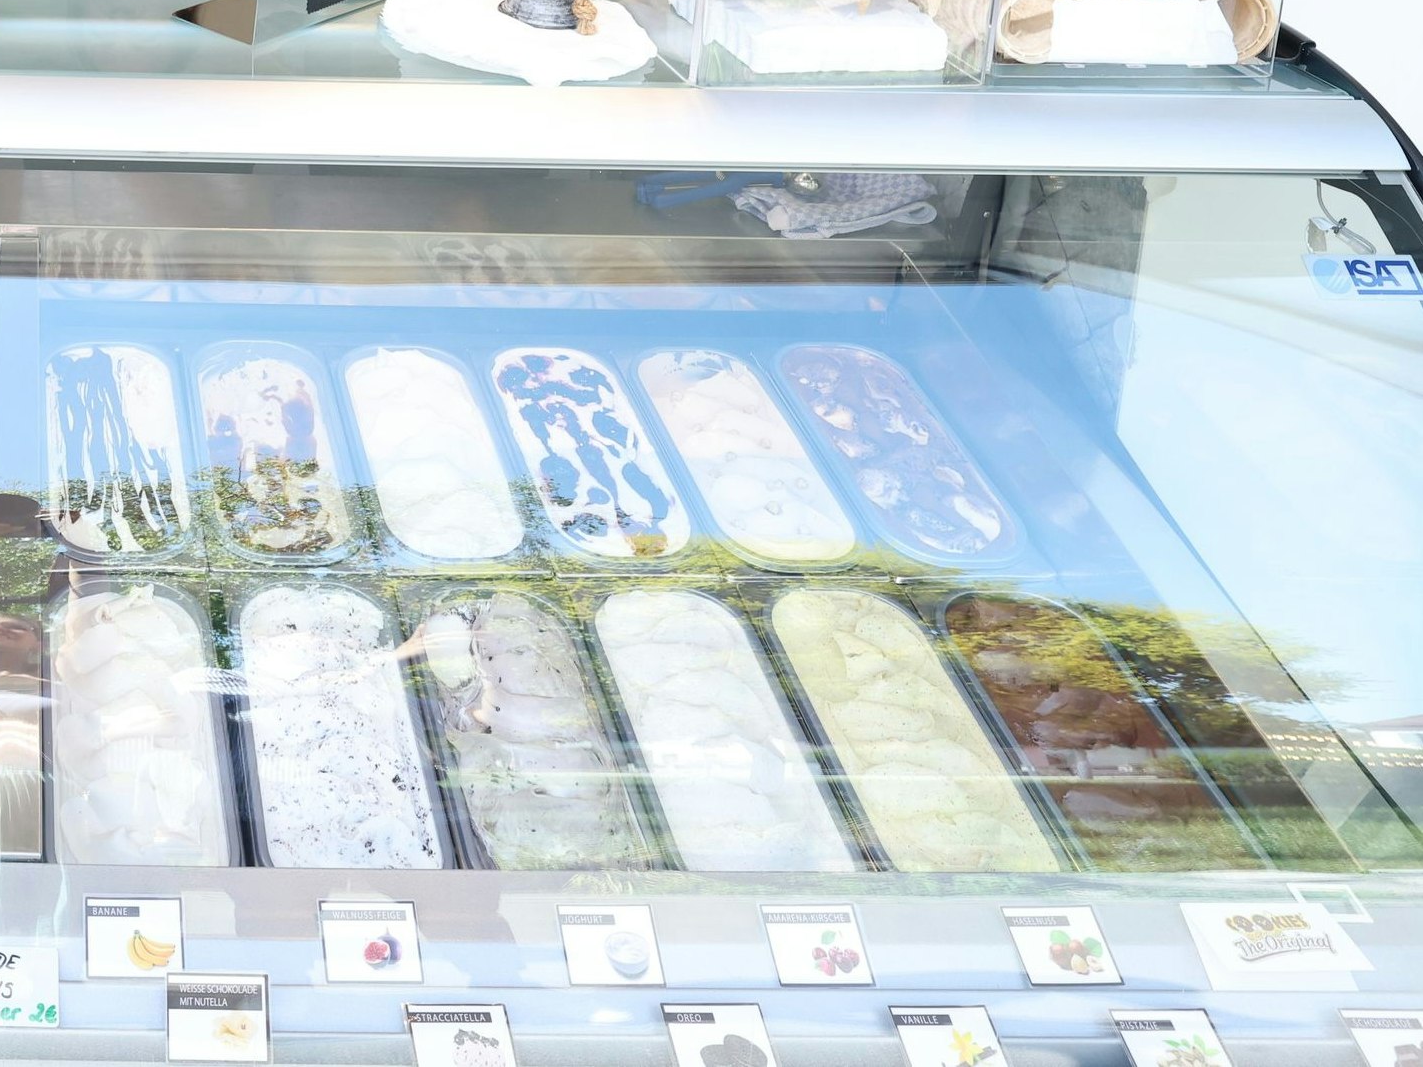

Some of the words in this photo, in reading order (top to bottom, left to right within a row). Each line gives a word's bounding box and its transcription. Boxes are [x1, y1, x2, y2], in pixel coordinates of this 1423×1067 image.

[1342, 259, 1403, 288] ISA
[92, 906, 128, 916] BANANE
[563, 915, 604, 925] JOGHURT
[1234, 938, 1266, 958] The
[1264, 932, 1337, 954] Original
[179, 984, 207, 994] WEISSE
[207, 984, 259, 995] SCHOKOLADE
[179, 997, 194, 1006] MIT
[194, 997, 228, 1008] NUTELLA
[416, 1012, 488, 1023] STRACCIATELLA
[676, 1013, 702, 1023] OREO
[900, 1015, 939, 1025] VANILLE
[1119, 1020, 1160, 1031] PISTAZIE
[1351, 1018, 1412, 1029] SCHOKOLADE
